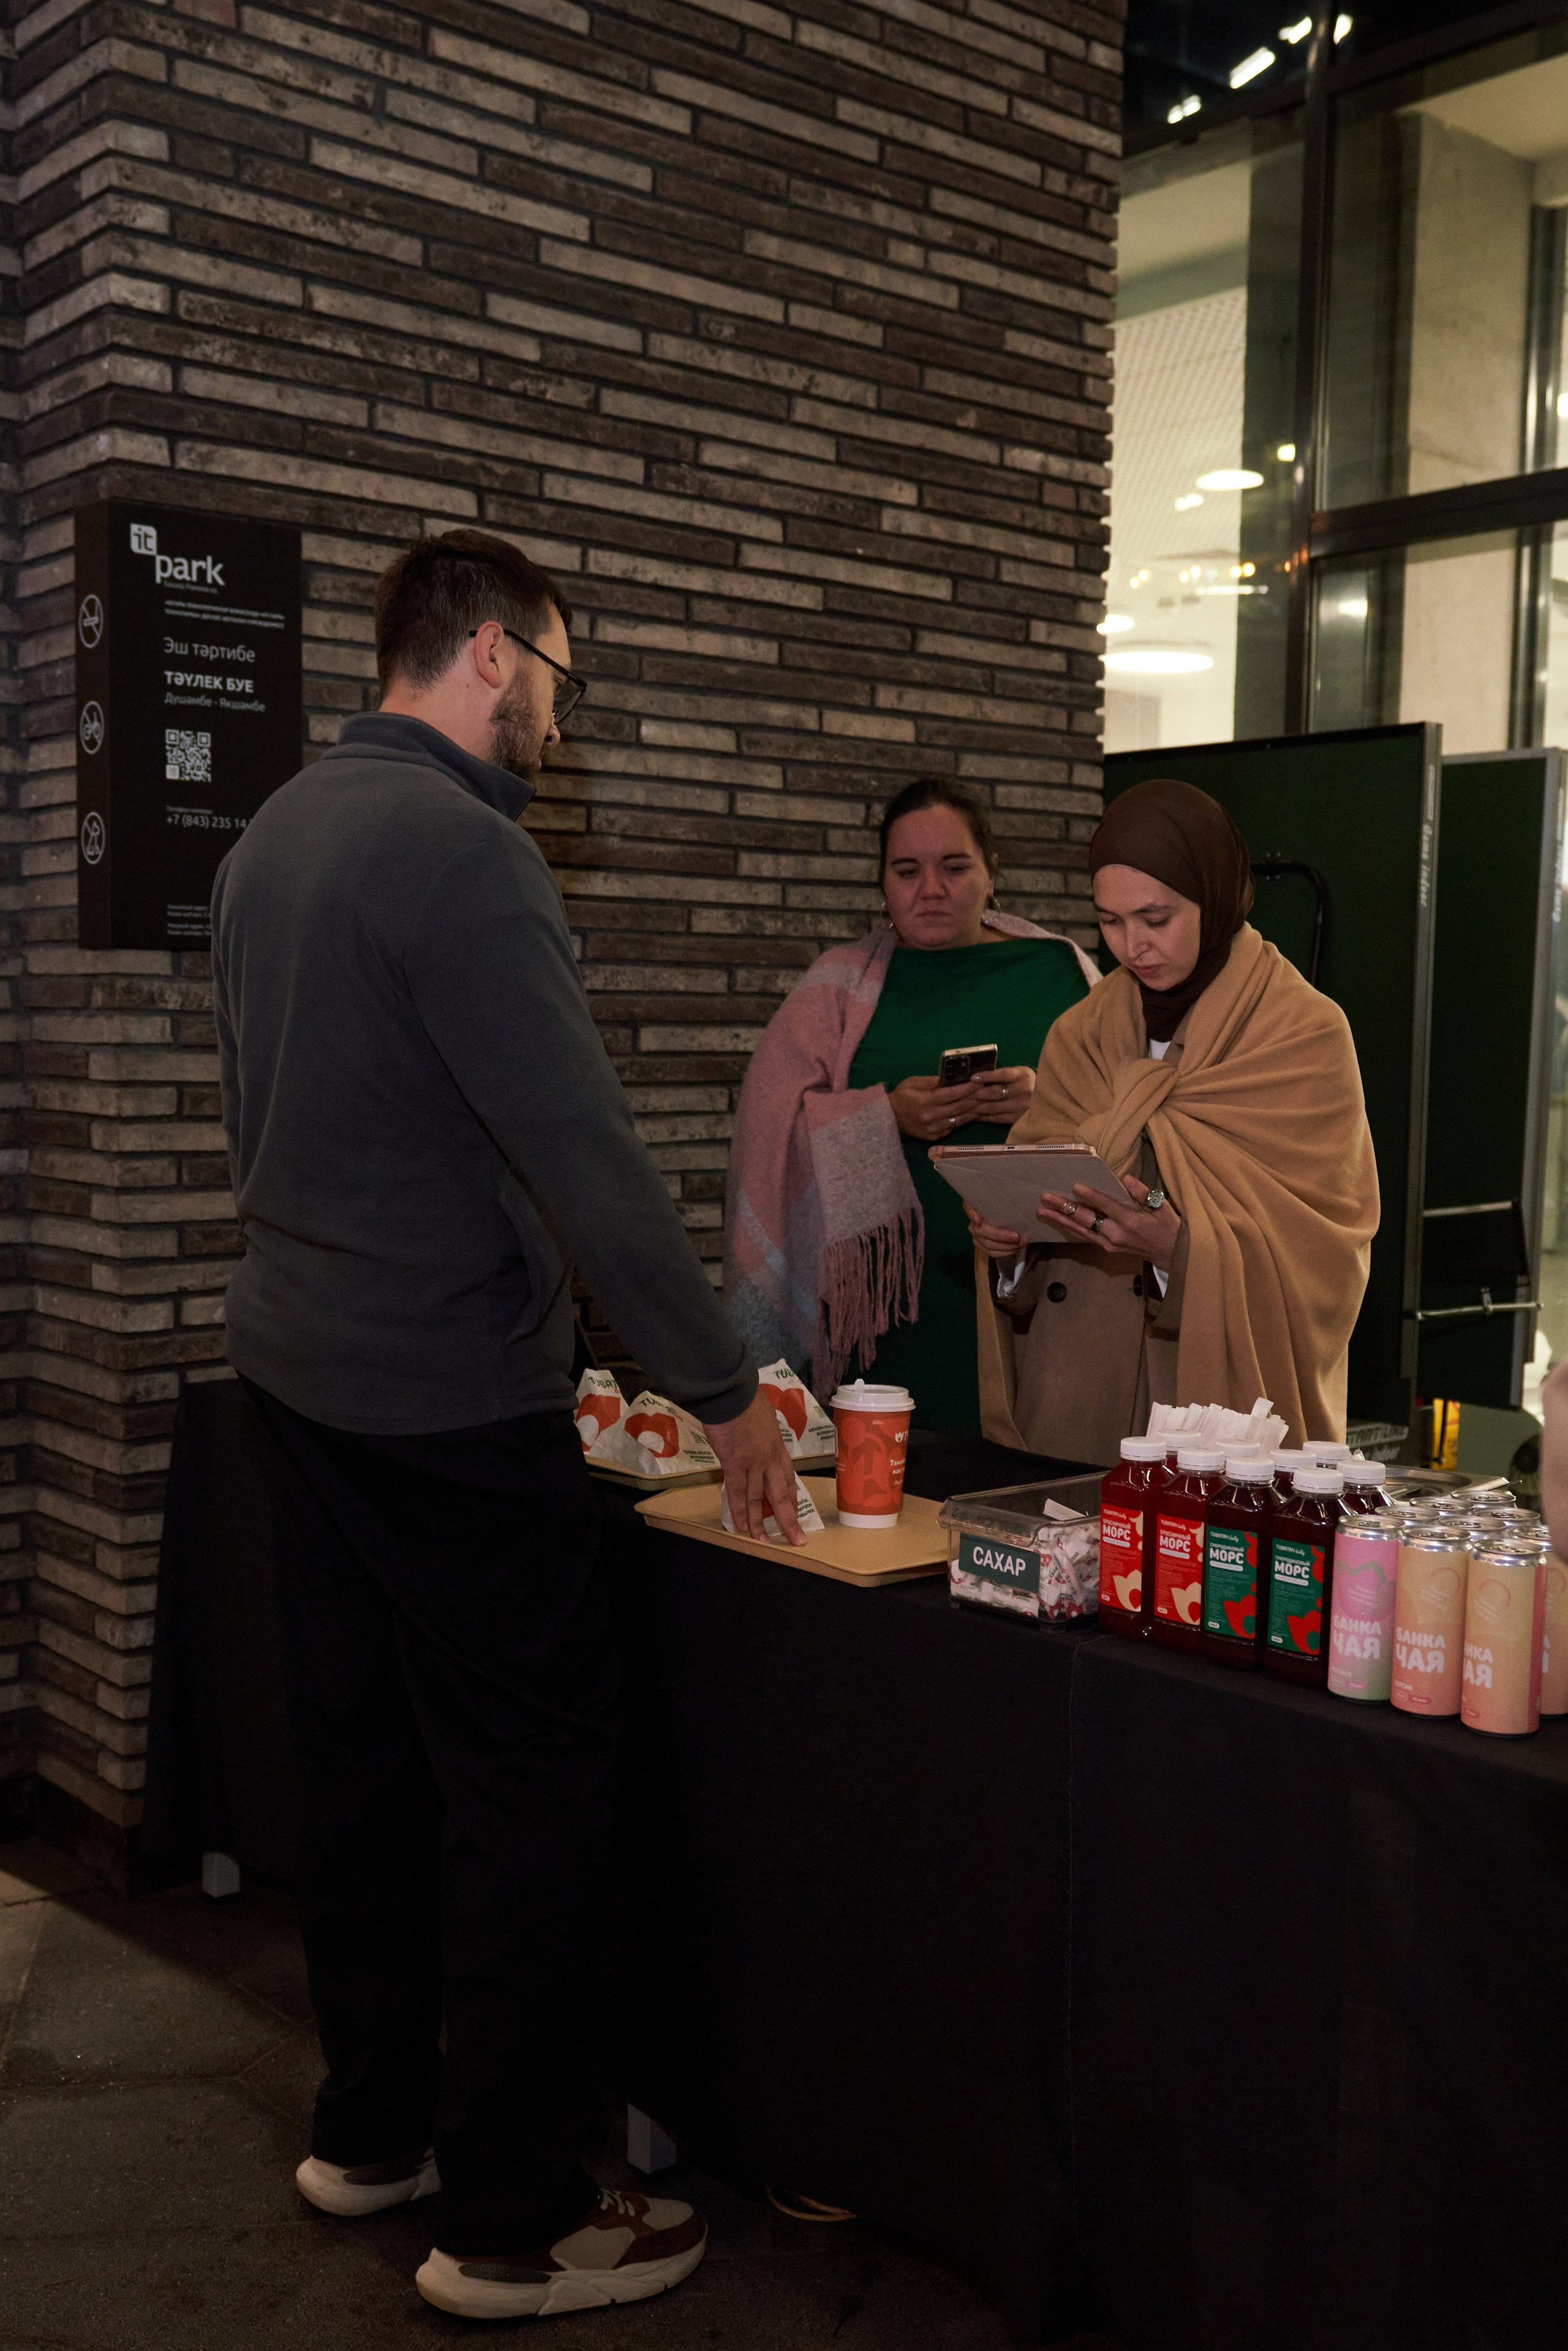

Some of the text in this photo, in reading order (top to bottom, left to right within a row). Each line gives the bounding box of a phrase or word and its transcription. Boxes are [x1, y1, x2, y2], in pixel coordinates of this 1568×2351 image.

[133, 527, 154, 551] it
[155, 554, 225, 586] park
[163, 636, 256, 663] Эш тәртибе
[226, 678, 255, 693] БУЕ
[166, 814, 180, 826] +7
[183, 815, 210, 829] (843)
[211, 817, 232, 829] 235
[234, 818, 246, 829] 14
[588, 1376, 618, 1389] TUBAT
[1102, 1523, 1131, 1541] МОРС
[1159, 1535, 1191, 1552] МОРС
[973, 1546, 1026, 1577] САХАР
[1209, 1547, 1244, 1564] МОРС
[1275, 1560, 1310, 1579] МОРС
[1333, 1614, 1382, 1636] БАНКА
[1333, 1634, 1381, 1660] ЧАЯ
[1396, 1627, 1446, 1649] БАНКА
[1395, 1643, 1446, 1674] ЧАЯ
[1464, 1643, 1493, 1664] НКА
[1463, 1664, 1493, 1689] АЯ
